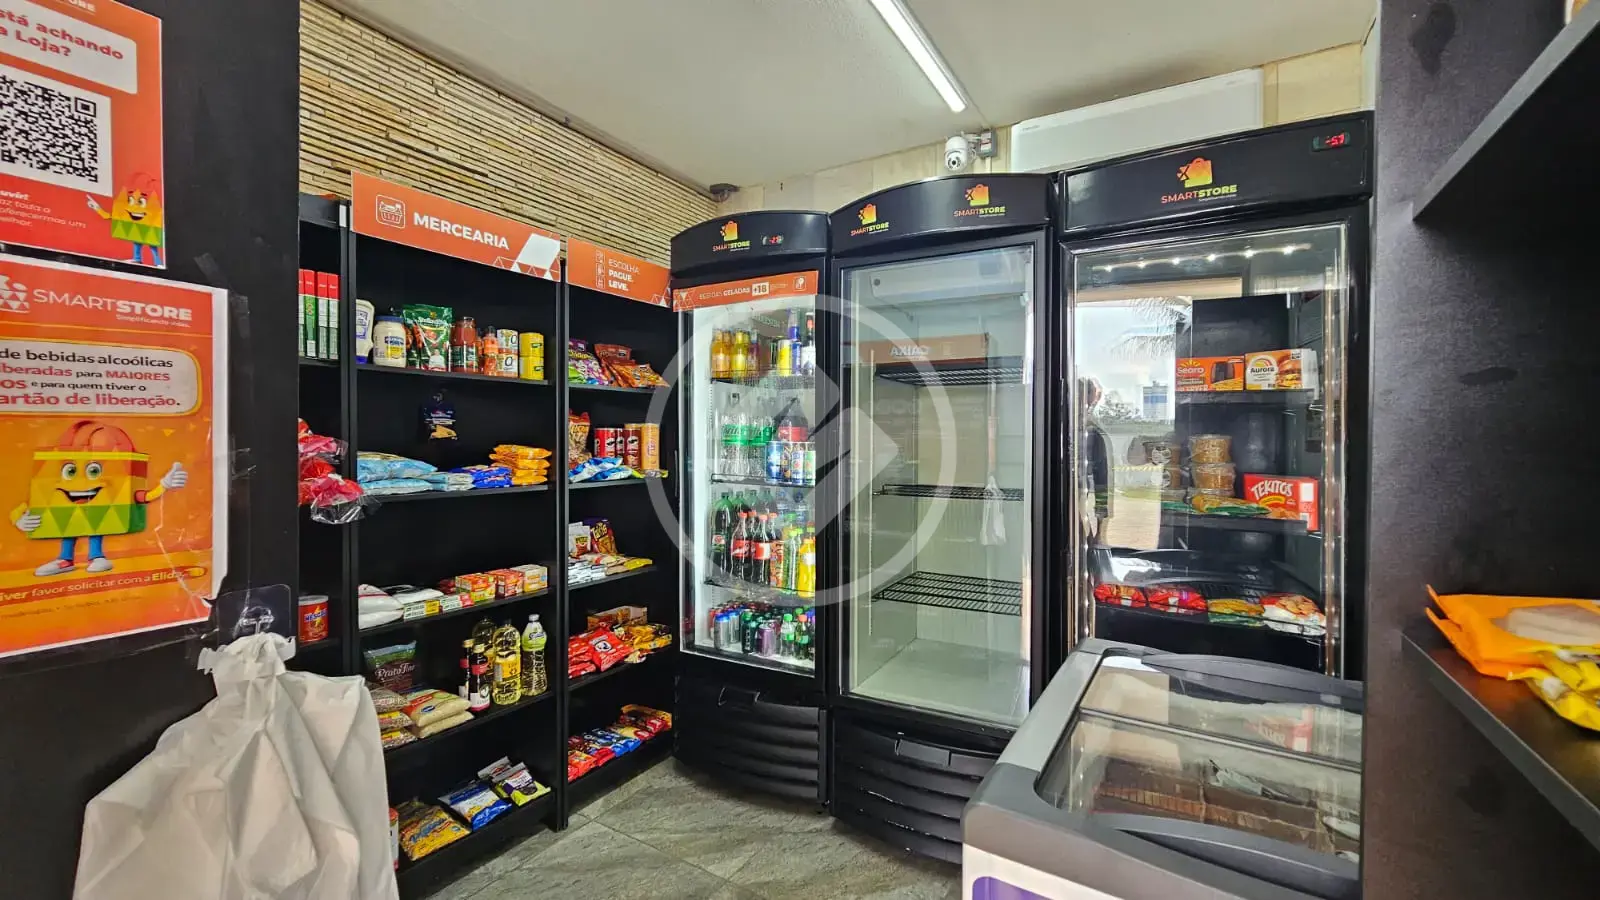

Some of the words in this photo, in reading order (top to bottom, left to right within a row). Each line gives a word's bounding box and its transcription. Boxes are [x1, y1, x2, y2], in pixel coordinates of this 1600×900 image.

[15, 29, 71, 56] Loja?
[36, 22, 123, 59] achando
[1160, 184, 1238, 204] SMARTSTORE
[953, 205, 1006, 217] SMARTSTORE
[413, 211, 510, 250] MERCEARIA
[850, 222, 889, 237] SMARTSTORE
[754, 284, 768, 294] +18
[32, 289, 193, 321] SMARTSTORE
[26, 349, 95, 363] bebidas
[97, 354, 173, 367] alcoólicas
[76, 370, 103, 378] para
[105, 370, 170, 381] MAIORES
[1250, 367, 1276, 377] Aurora
[67, 382, 103, 390] quem
[105, 382, 136, 391] tiver
[65, 392, 90, 405] de
[95, 393, 181, 408] liberação.
[1250, 479, 1294, 500] TEKITOS
[31, 587, 65, 597] favor
[67, 579, 115, 592] solicitar
[118, 577, 142, 585] com
